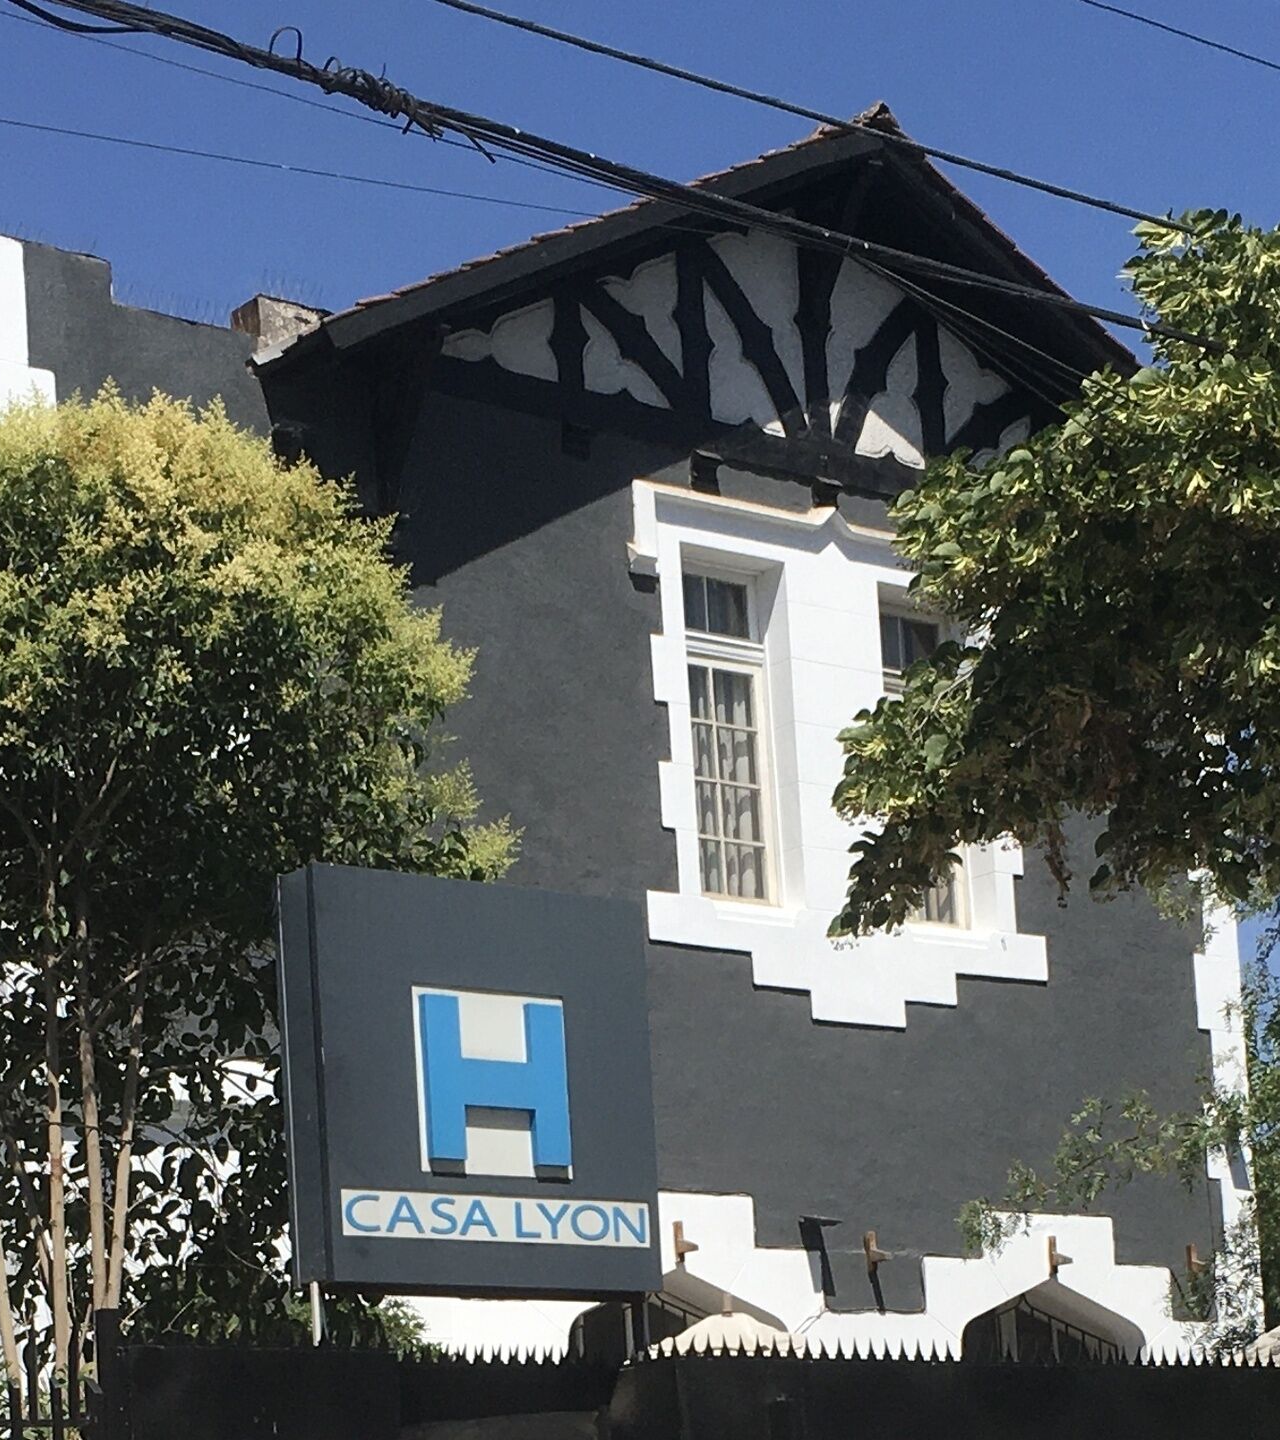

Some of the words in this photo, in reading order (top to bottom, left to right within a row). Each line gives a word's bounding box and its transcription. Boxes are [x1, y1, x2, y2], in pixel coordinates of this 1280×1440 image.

[418, 993, 572, 1168] H
[344, 1193, 497, 1238] CASA
[513, 1201, 647, 1245] LYON
